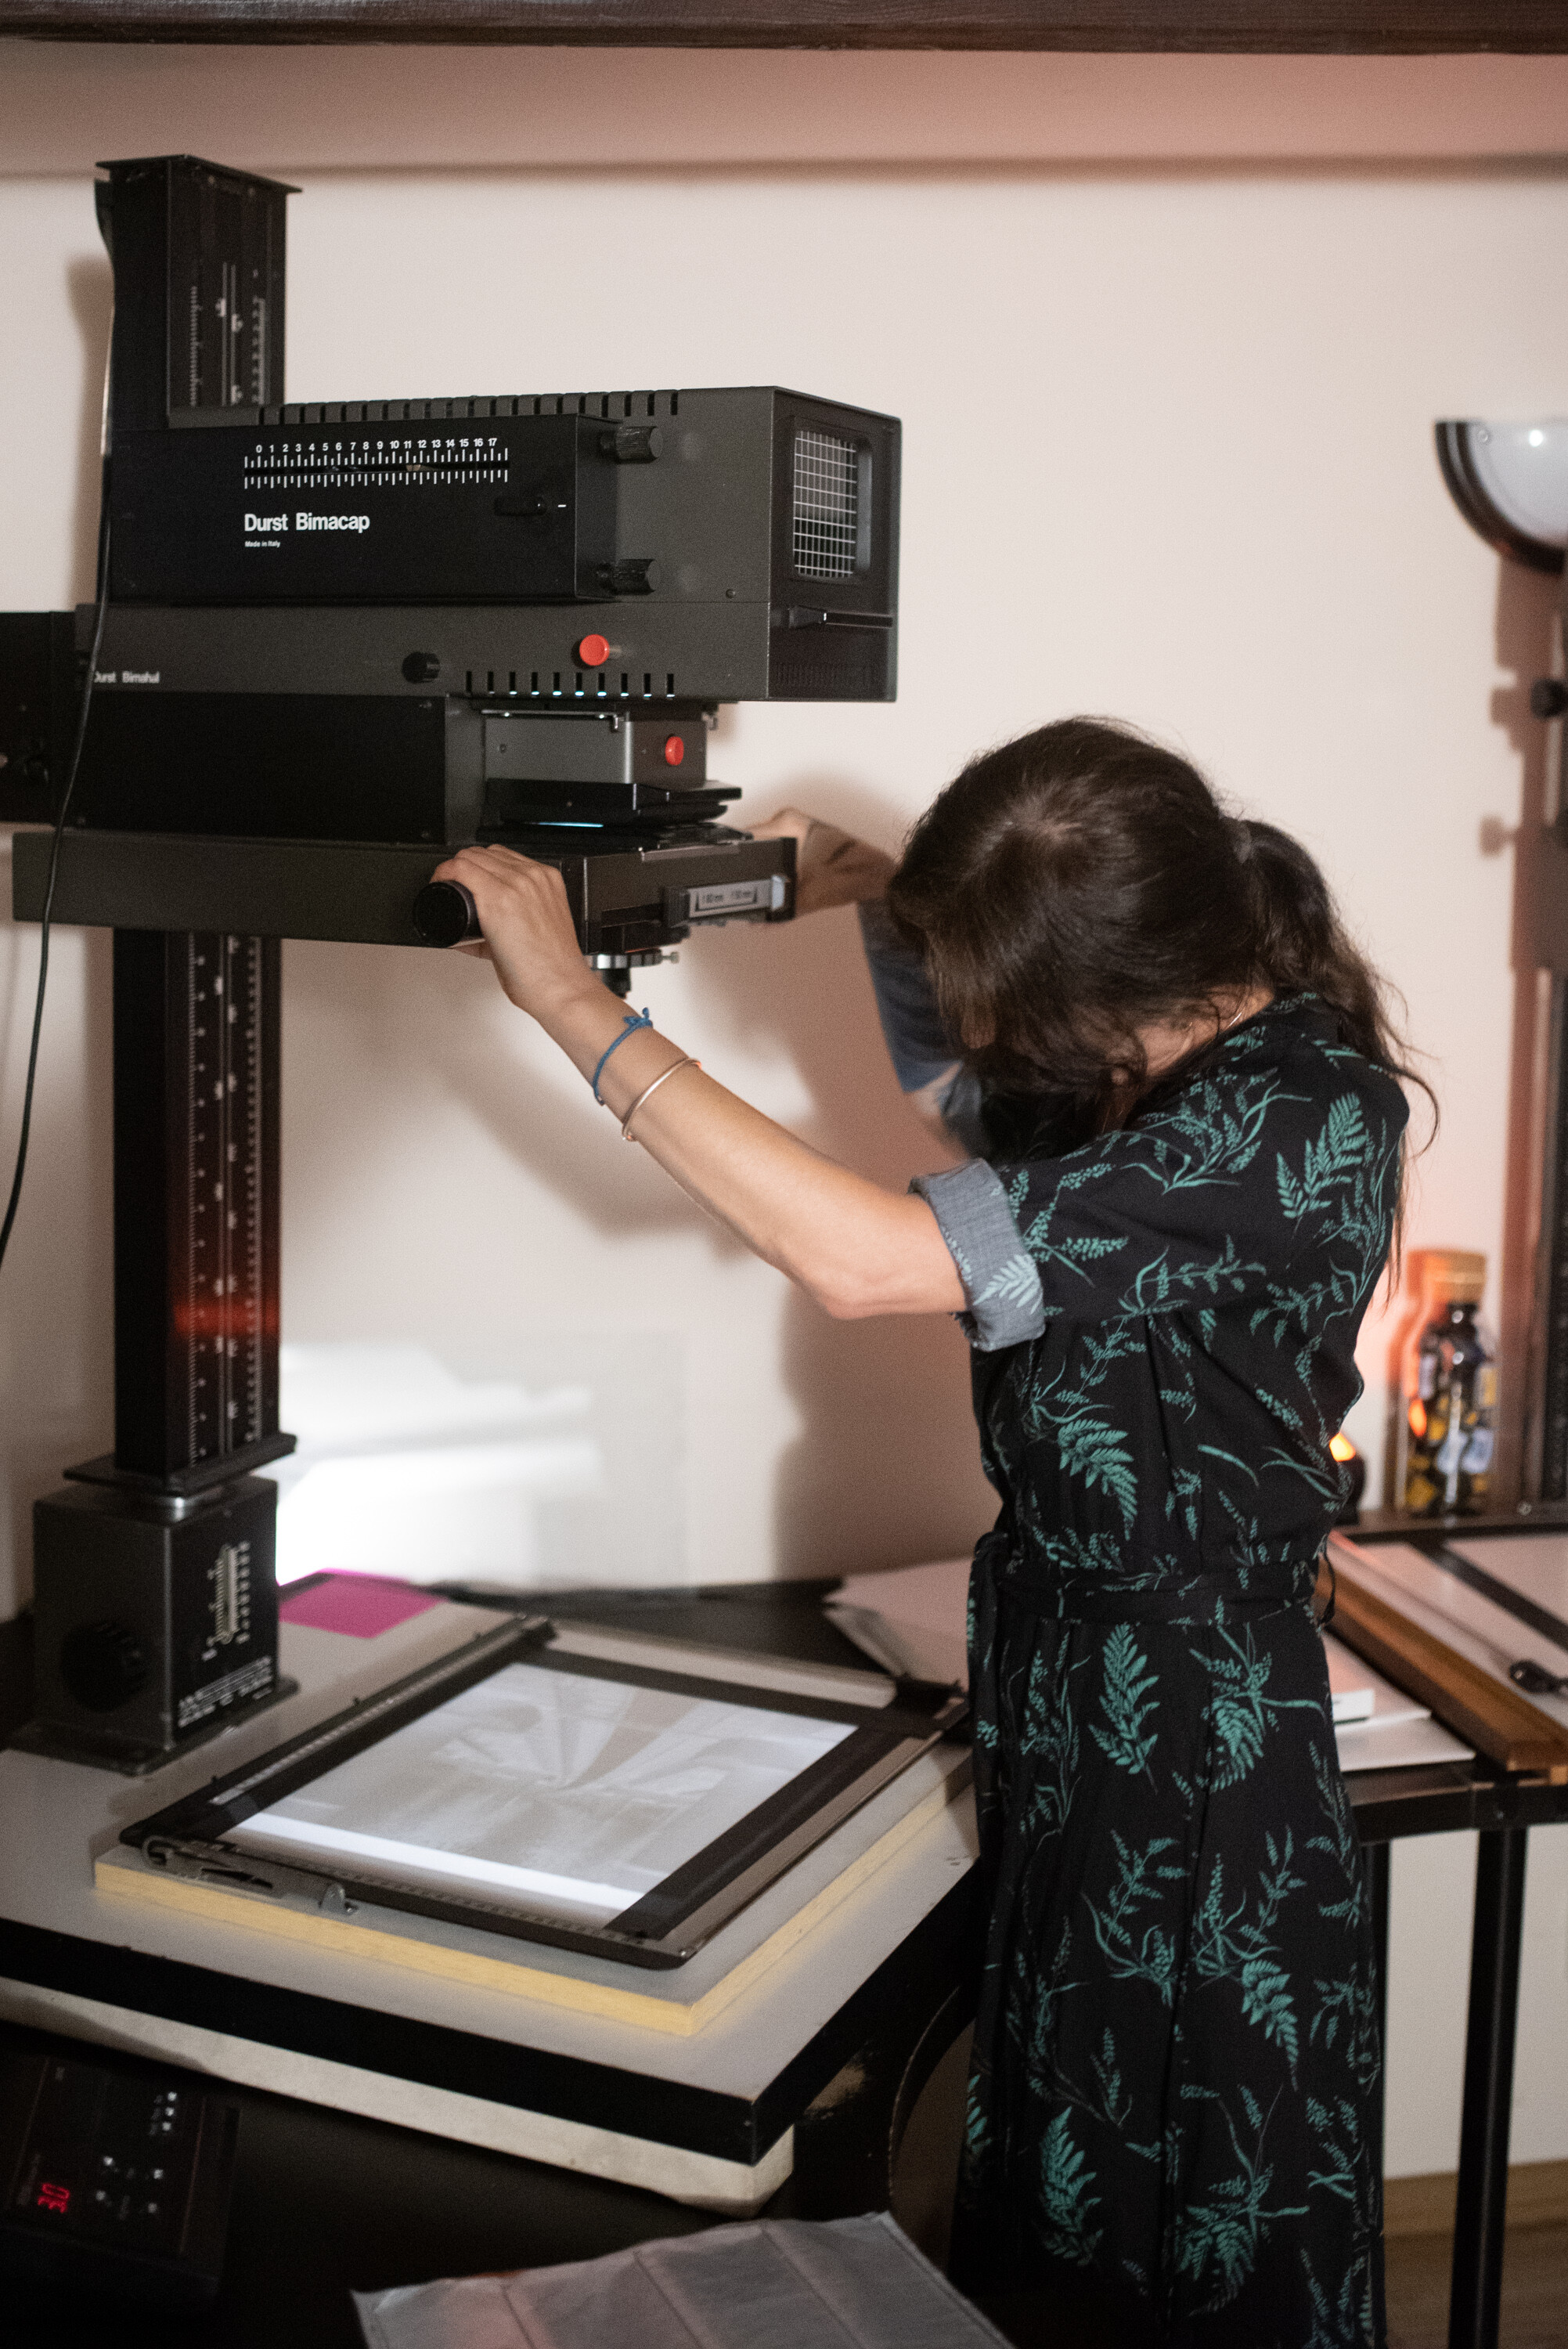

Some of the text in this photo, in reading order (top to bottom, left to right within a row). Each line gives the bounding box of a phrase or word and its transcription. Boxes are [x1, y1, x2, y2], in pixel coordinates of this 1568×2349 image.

[255, 437, 498, 453] 0 1 2 3 4 5 6 7 8 9 10 11 12 13 14 15 16 17
[244, 512, 370, 534] Durst Bimacap
[267, 539, 281, 548] Italy
[37, 2182, 71, 2214] 30
